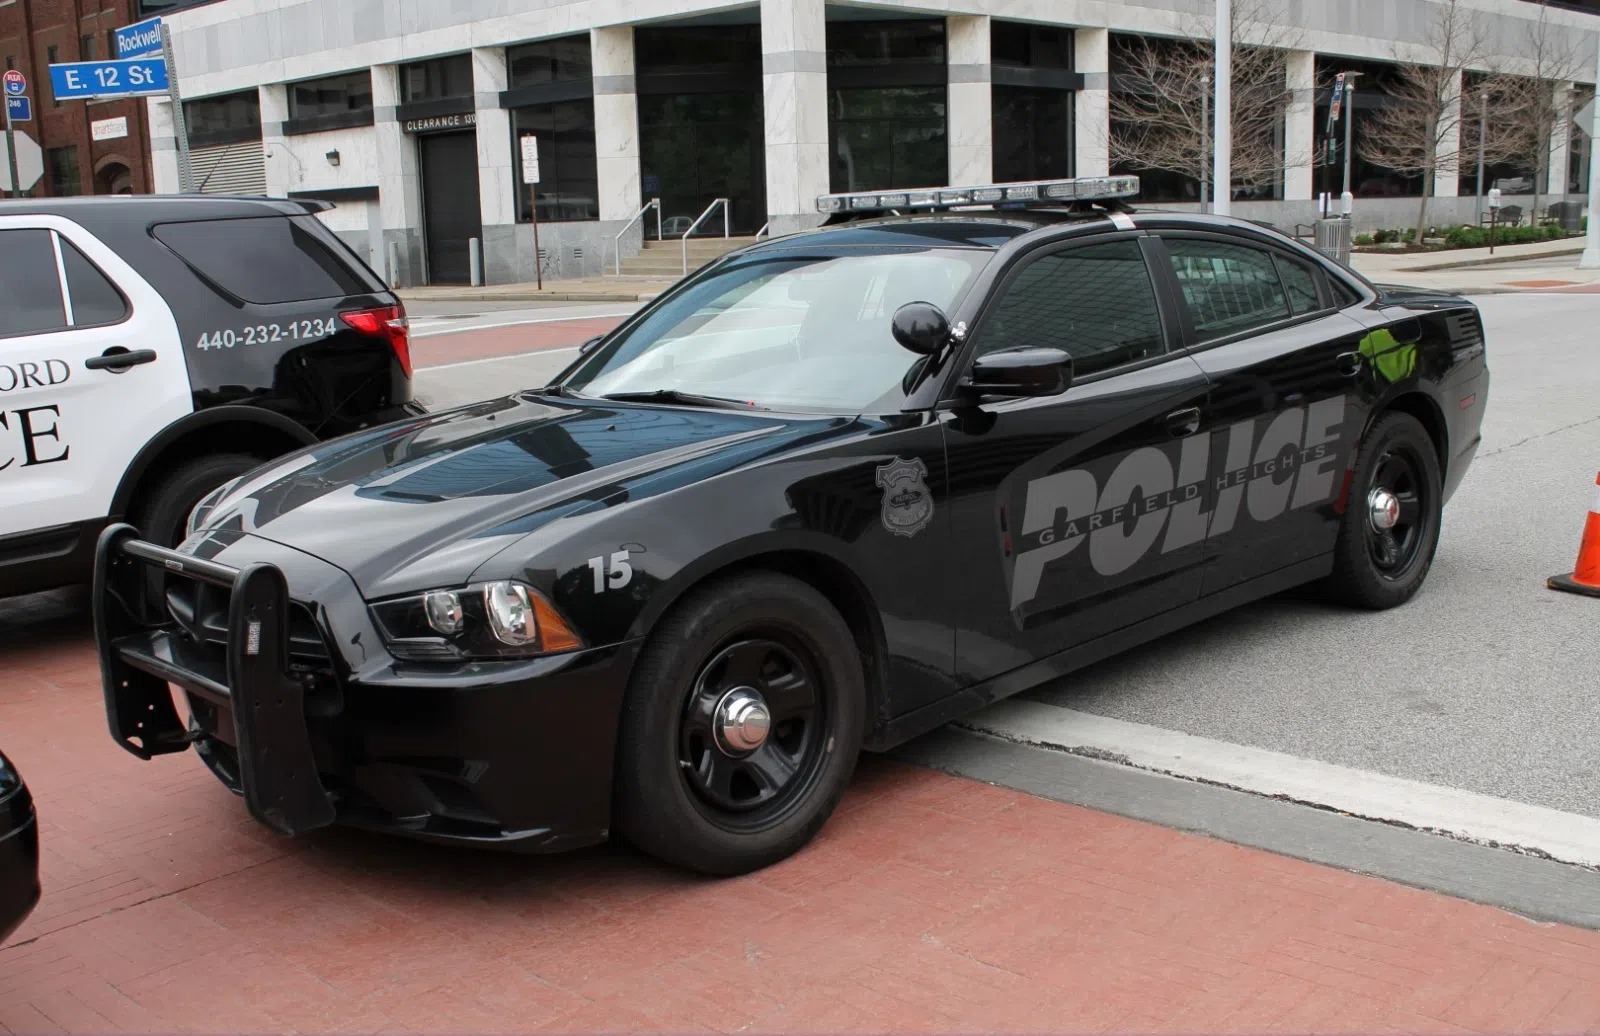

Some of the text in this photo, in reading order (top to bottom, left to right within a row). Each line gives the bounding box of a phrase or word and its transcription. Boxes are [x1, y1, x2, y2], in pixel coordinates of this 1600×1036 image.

[118, 23, 162, 53] Rockwell
[7, 74, 21, 82] RTA
[65, 65, 154, 90] E. 12 St
[9, 100, 22, 108] 246
[407, 115, 460, 131] CLEARANCE
[196, 317, 337, 352] 440-232-1234
[1010, 394, 1346, 612] POLICE
[1038, 443, 1327, 546] GARFIELD HEIGHTS
[588, 550, 633, 594] 15
